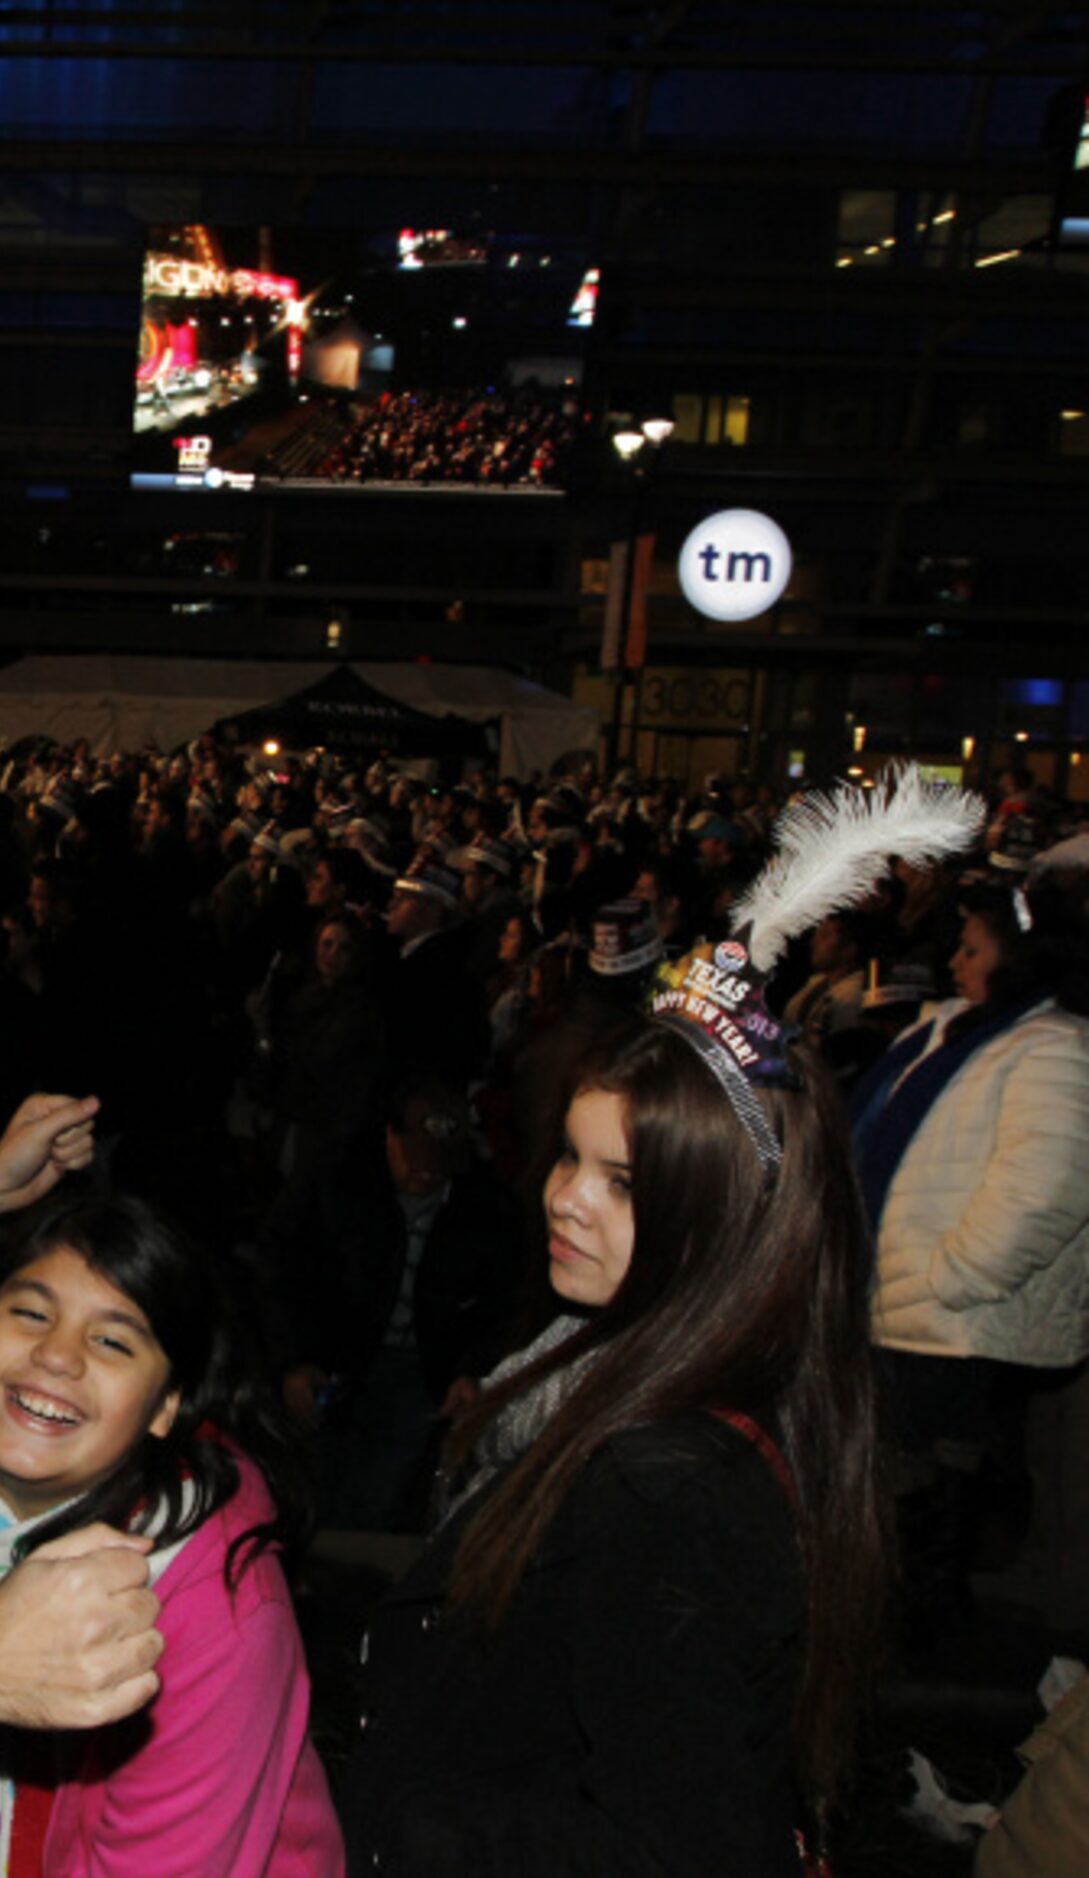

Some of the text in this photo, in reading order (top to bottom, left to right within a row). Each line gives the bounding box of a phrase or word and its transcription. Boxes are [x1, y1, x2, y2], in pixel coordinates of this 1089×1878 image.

[699, 543, 771, 582] tm
[644, 675, 749, 719] 3030
[688, 957, 752, 1003] TEXAS
[714, 1015, 760, 1067] YEAR!
